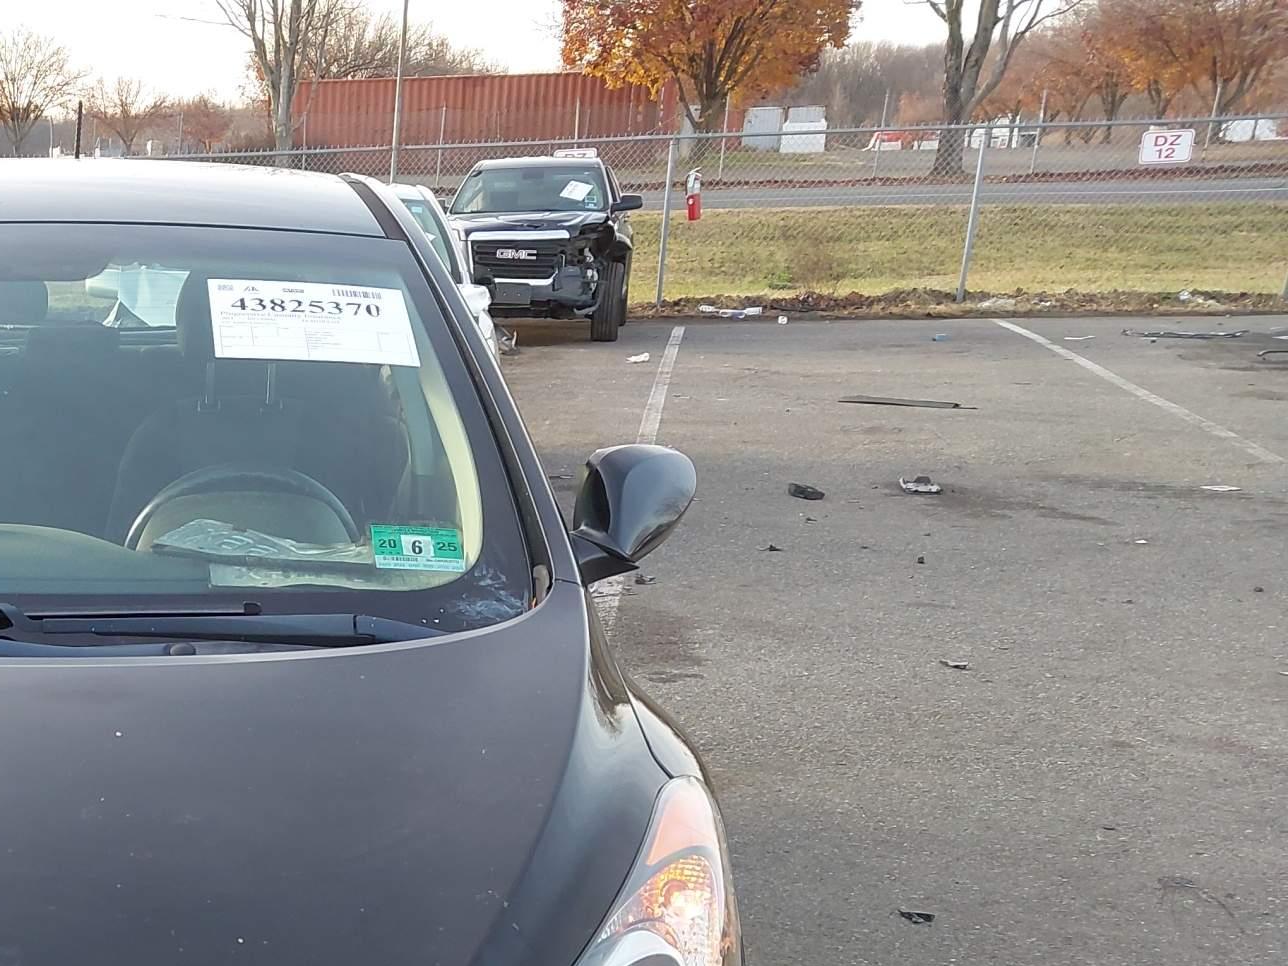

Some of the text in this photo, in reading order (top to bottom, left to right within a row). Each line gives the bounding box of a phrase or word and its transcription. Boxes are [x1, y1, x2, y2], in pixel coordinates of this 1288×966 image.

[1154, 134, 1183, 147] DZ
[1155, 147, 1176, 159] 12
[495, 248, 537, 260] GMC
[231, 297, 381, 318] 43825370
[378, 538, 458, 555] 20 6 25
